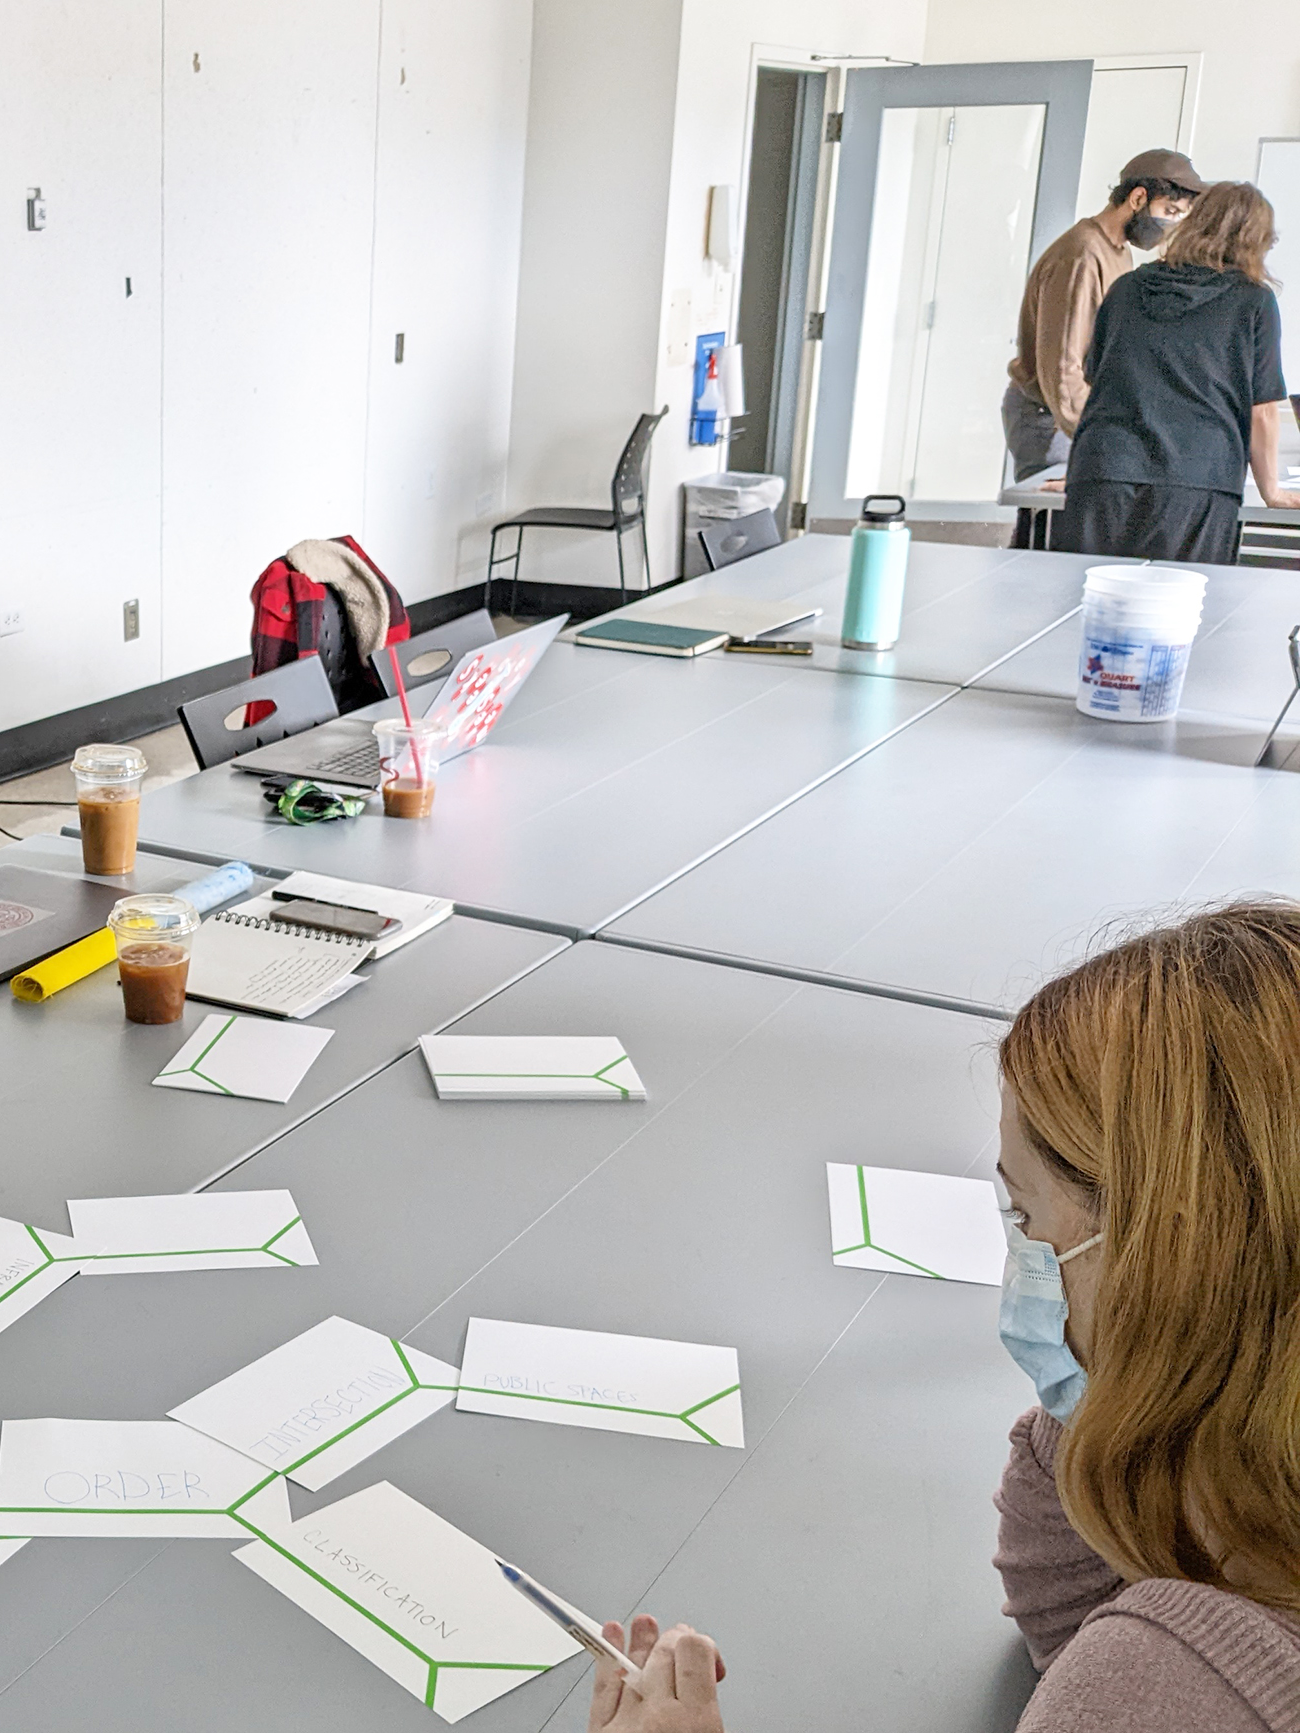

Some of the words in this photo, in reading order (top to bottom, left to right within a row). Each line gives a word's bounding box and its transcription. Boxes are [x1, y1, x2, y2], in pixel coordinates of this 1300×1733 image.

[249, 1365, 405, 1461] INTERSECTION
[483, 1372, 559, 1396] PUBLIC
[567, 1383, 639, 1404] SPACES
[44, 1470, 210, 1504] ORDER
[303, 1529, 459, 1639] CLASSIFICATION
